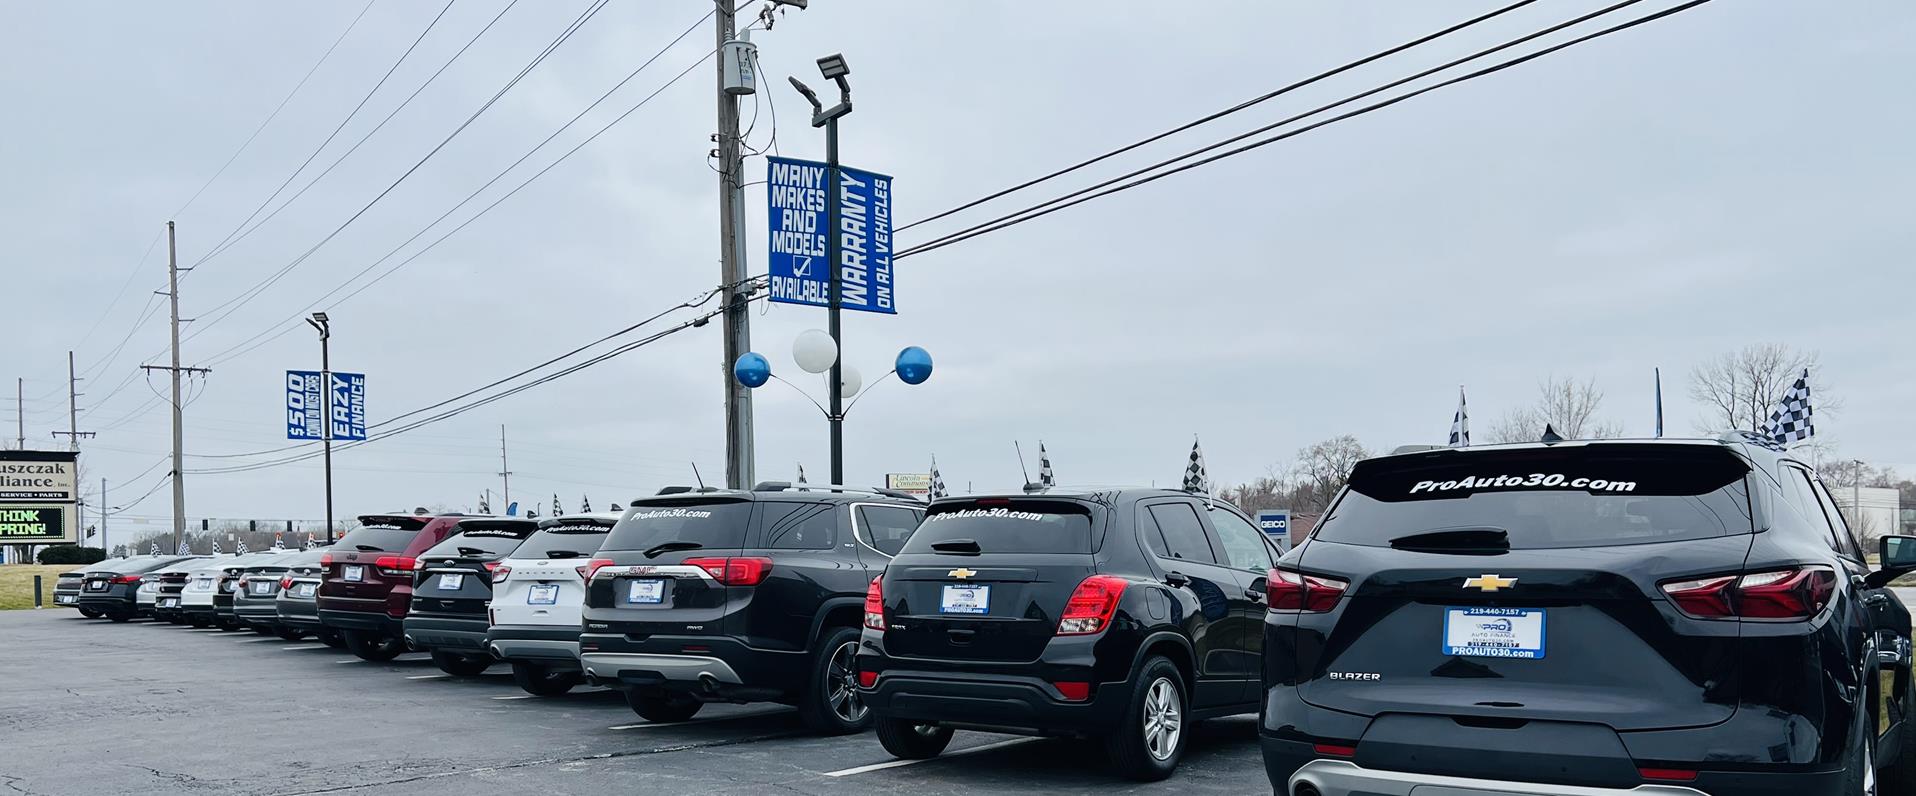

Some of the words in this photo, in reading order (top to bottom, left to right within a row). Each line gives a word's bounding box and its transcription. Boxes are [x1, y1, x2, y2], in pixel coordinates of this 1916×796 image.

[772, 163, 824, 188] MANY
[772, 186, 825, 212] MAKES
[782, 210, 816, 233] AND
[875, 180, 889, 253] VEHICLES
[772, 231, 825, 257] MODELS
[840, 171, 868, 306] WARRANTY
[876, 256, 890, 284] ALL
[771, 276, 829, 303] AVAILABLE
[877, 287, 891, 308] ON
[288, 374, 305, 436] $500
[333, 376, 349, 437] EAZY
[352, 377, 364, 437] FINANCE
[1408, 473, 1637, 494] ProAuto30.com
[631, 508, 711, 521] ProAuto30.com
[933, 508, 1043, 521] ProAuto30.com
[1261, 520, 1286, 529] GEICO
[1452, 647, 1534, 658] PROAUTO30.com
[1329, 671, 1381, 681] BLAZER
